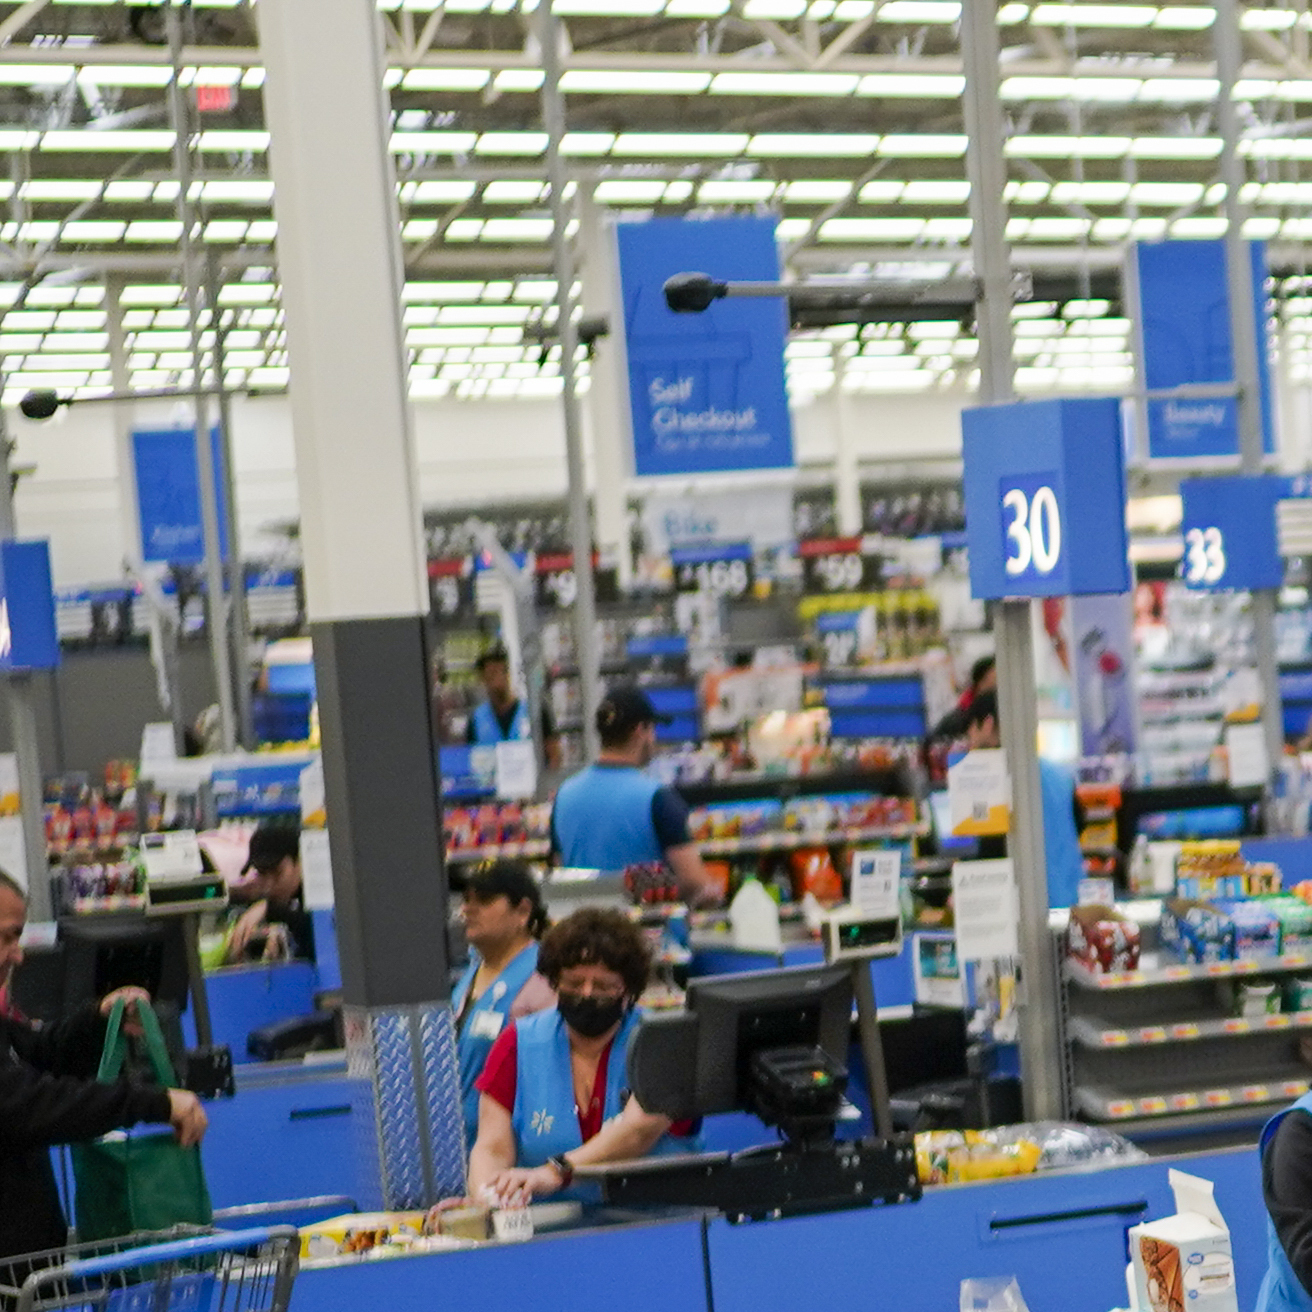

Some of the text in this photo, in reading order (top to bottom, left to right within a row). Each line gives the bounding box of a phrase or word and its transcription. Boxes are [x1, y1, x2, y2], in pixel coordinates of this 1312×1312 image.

[648, 375, 695, 404] Self
[652, 405, 757, 436] Checkout
[1003, 485, 1061, 575] 30
[1185, 525, 1227, 584] 33
